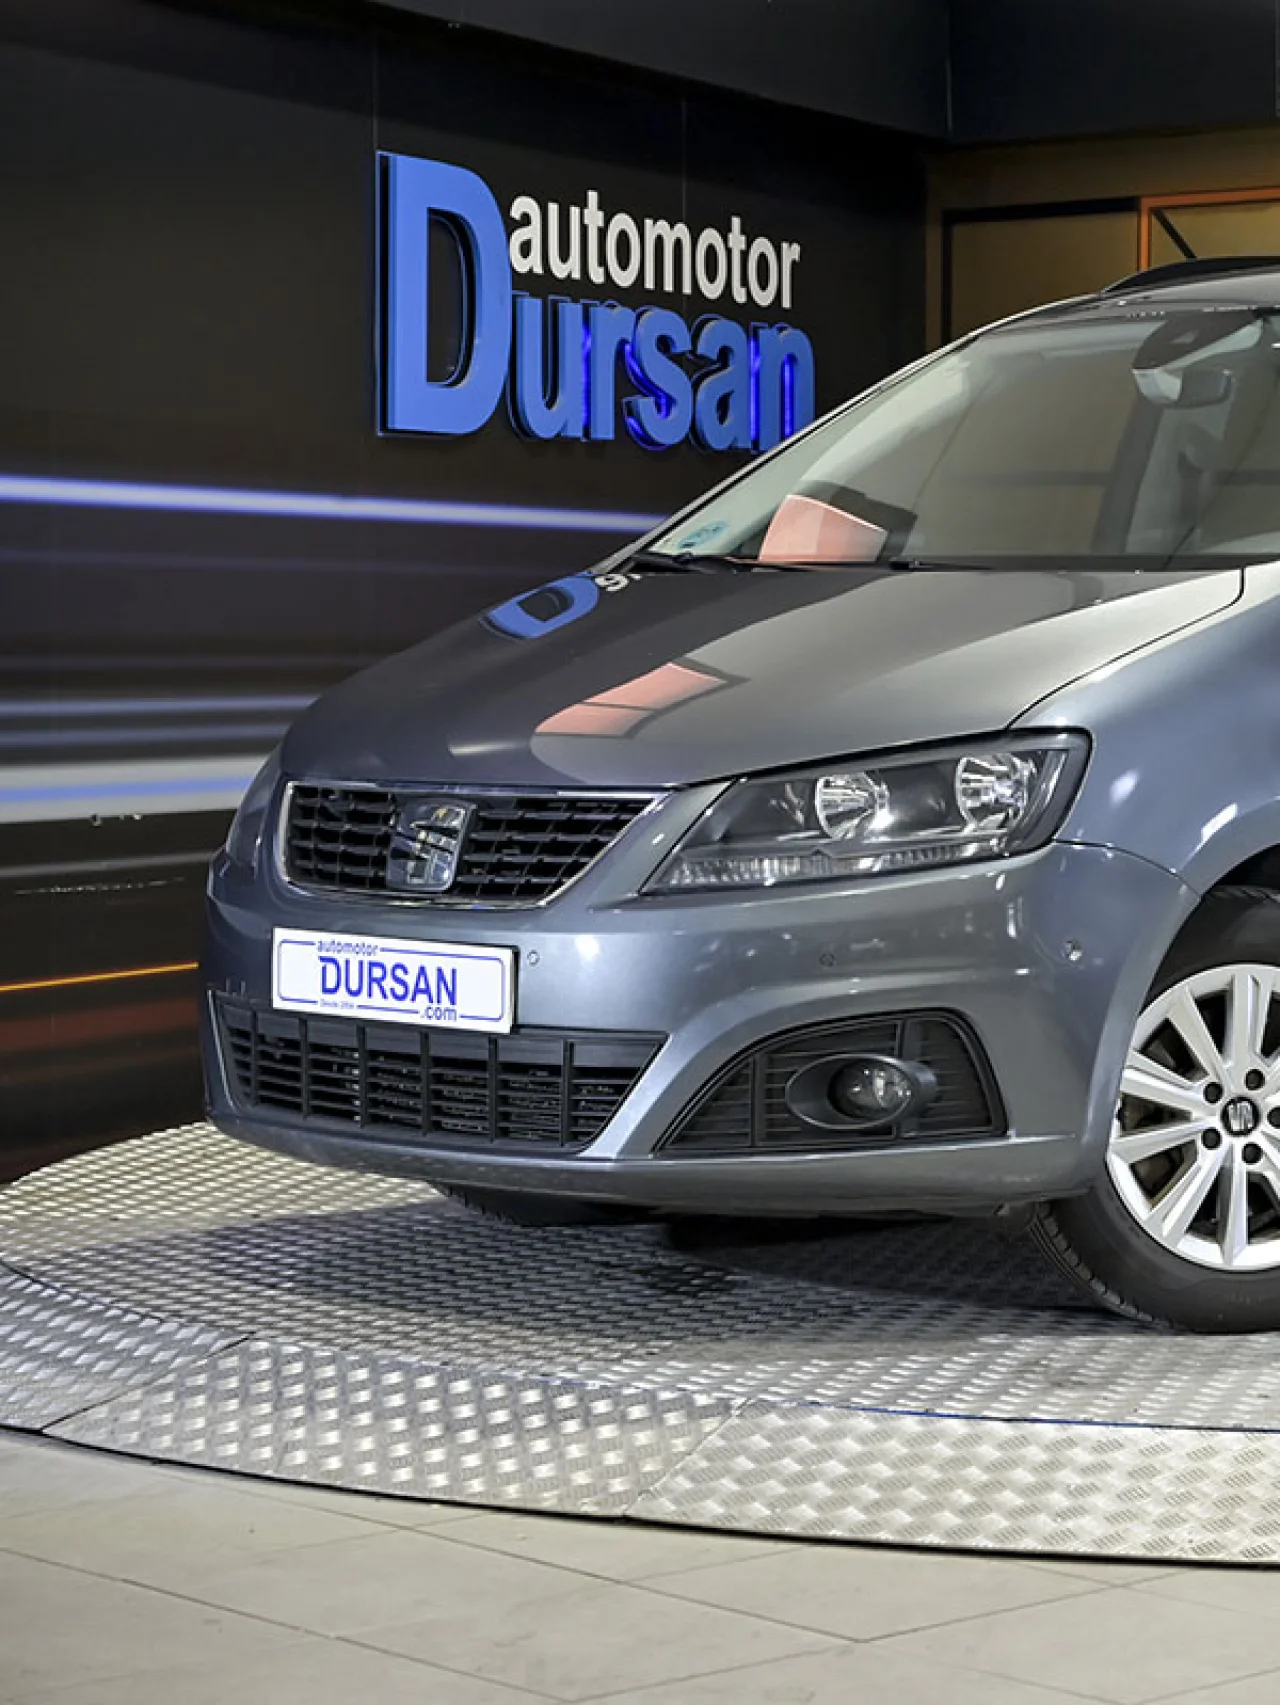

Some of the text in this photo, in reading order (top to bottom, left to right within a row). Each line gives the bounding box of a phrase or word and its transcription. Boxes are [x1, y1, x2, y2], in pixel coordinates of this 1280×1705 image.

[508, 190, 801, 309] automotor
[377, 150, 816, 453] Dursan
[316, 939, 379, 957] automotor
[317, 955, 458, 1006] DURSAN
[420, 1005, 458, 1021] .com
